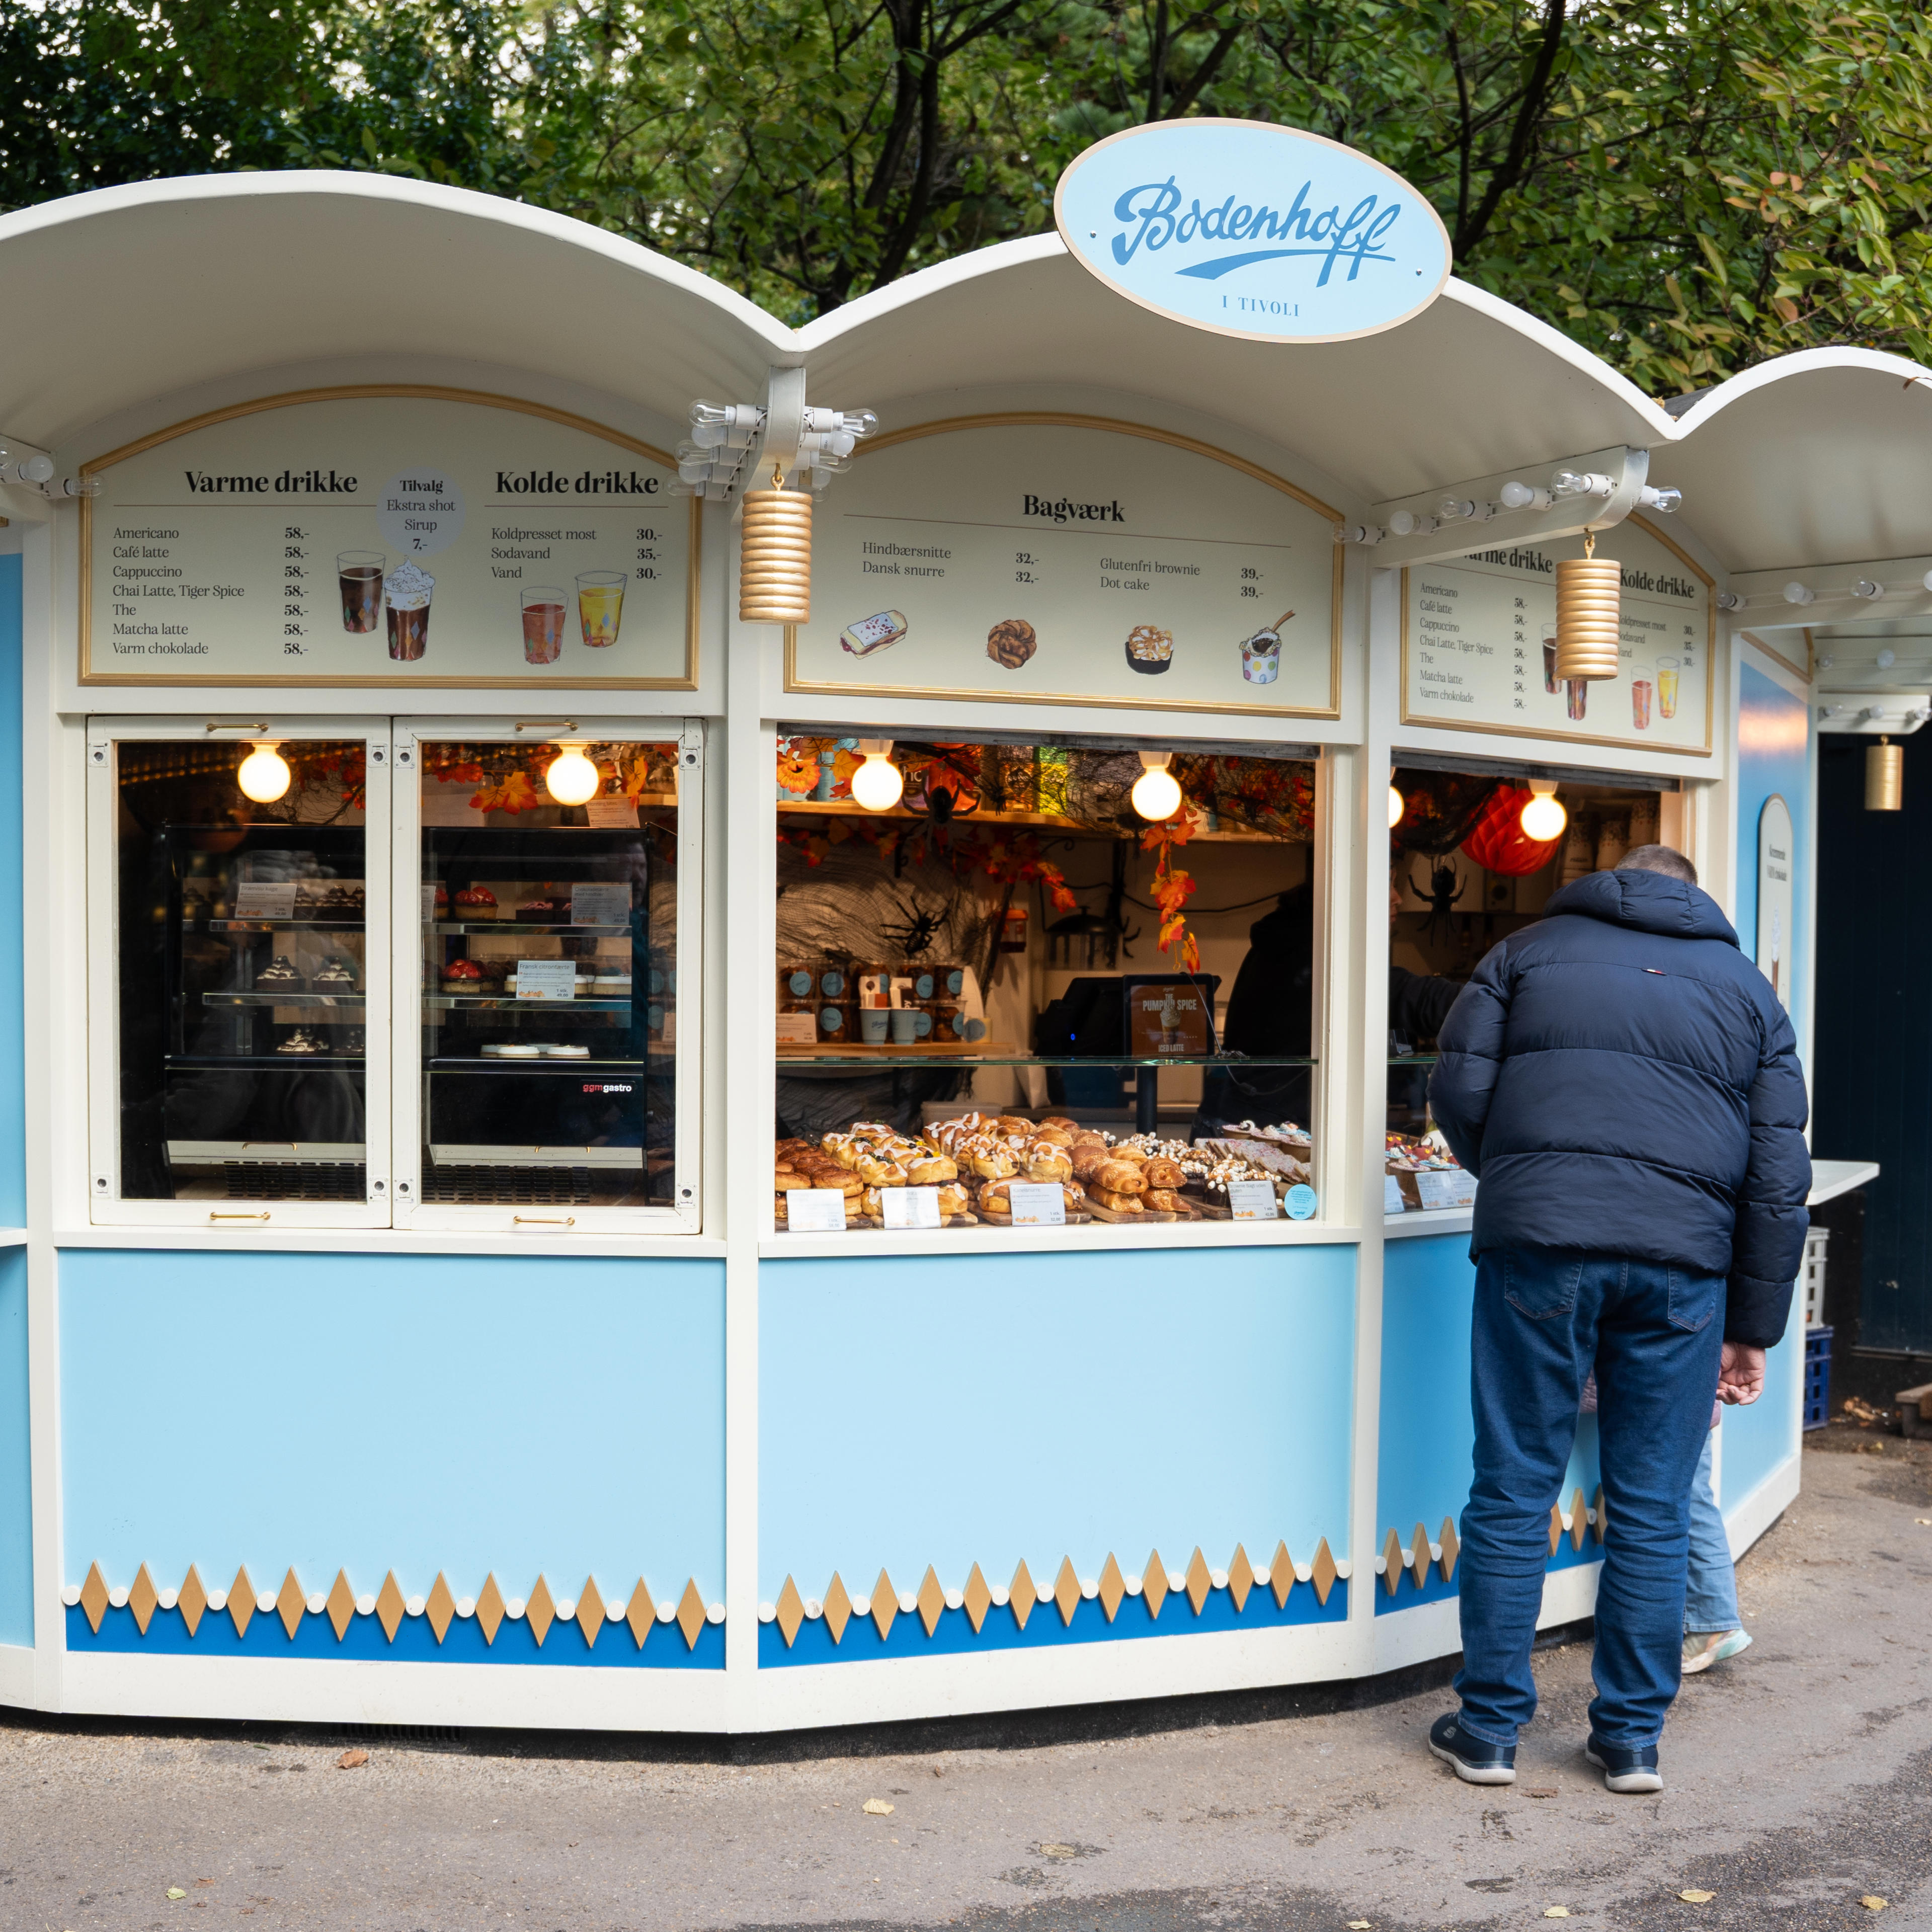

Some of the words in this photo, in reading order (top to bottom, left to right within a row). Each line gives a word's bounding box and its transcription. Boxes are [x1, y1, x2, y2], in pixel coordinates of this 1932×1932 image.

[1111, 175, 1401, 288] Bodenhoff
[1223, 295, 1227, 308] I
[1239, 297, 1300, 317] TIVOLI
[184, 471, 269, 493] Varme
[274, 470, 358, 493] drikke
[399, 479, 443, 495] Tilvalg
[495, 470, 569, 494] Kolde
[575, 470, 659, 494] drikke
[386, 499, 427, 512] Ekstra
[428, 499, 456, 511] shot
[1022, 495, 1125, 524] Bagværk
[404, 518, 437, 533] Sirup
[113, 527, 180, 539] Americano
[285, 527, 309, 540] 58,-
[491, 527, 563, 543] Koldpresset
[566, 530, 597, 540] most
[636, 528, 663, 542] 30,-
[413, 538, 428, 551] 7,-
[862, 542, 951, 559] Hindbærsnitte
[113, 545, 140, 558] Café
[142, 545, 169, 558] latte
[284, 546, 309, 559] 58,-
[491, 546, 550, 559] Sodavand
[637, 547, 662, 561] 35,-
[1016, 552, 1039, 566] 32,-
[1464, 550, 1506, 566] arme
[1509, 548, 1553, 574] drikke
[113, 565, 182, 580] Cappuccino
[284, 565, 309, 579] 58,-
[491, 566, 522, 579] Vand
[862, 560, 901, 575] Dansk
[904, 567, 945, 578] snurre
[1100, 557, 1152, 573] Glutenfri
[1155, 561, 1200, 576] brownie
[636, 568, 662, 581] 30,-
[1015, 571, 1039, 584] 32,-
[1241, 568, 1264, 581] 39,-
[1100, 576, 1121, 589] Dot
[1123, 578, 1150, 591] cake
[1420, 582, 1458, 598] Americano
[1656, 575, 1695, 599] drikke
[113, 584, 140, 597] Chai
[142, 585, 176, 597] Latte,
[178, 585, 210, 600] Tiger
[212, 585, 245, 600] Spice
[284, 585, 309, 598] 58,-
[1241, 586, 1264, 599] 39,-
[112, 603, 136, 616] The
[1420, 599, 1436, 612] Café
[1436, 601, 1453, 615] latte
[1514, 597, 1528, 609] 58,-
[284, 604, 309, 617] 58,-
[1419, 617, 1460, 633] Cappuccino
[1514, 614, 1527, 626] 58,-
[1652, 622, 1666, 631] most
[113, 622, 159, 635] Matcha
[162, 622, 189, 635] latte
[284, 623, 308, 636] 58,-
[1683, 626, 1696, 636] 30,-
[1514, 631, 1527, 642] 58,-
[113, 642, 145, 654] Varm
[148, 642, 209, 654] chokolade
[284, 642, 308, 655] 58,-
[1419, 634, 1436, 647] Chai
[1437, 636, 1456, 651] Latte,
[1457, 639, 1475, 654] Tiger
[1475, 642, 1494, 656] Spice
[1683, 641, 1695, 651] 35,-
[1419, 652, 1434, 664] The
[1514, 648, 1527, 660] 58,-
[1683, 658, 1695, 667] 30,-
[1419, 669, 1446, 683] Matcha
[1447, 672, 1463, 685] latte
[1514, 665, 1527, 676] 58,-
[1514, 681, 1527, 693] 58,-
[1419, 686, 1439, 699] Varm
[1439, 689, 1474, 703] chokolade
[1513, 698, 1527, 709] 58,-
[1177, 999, 1196, 1010] SPICE
[583, 1084, 632, 1093] ggmgastro
